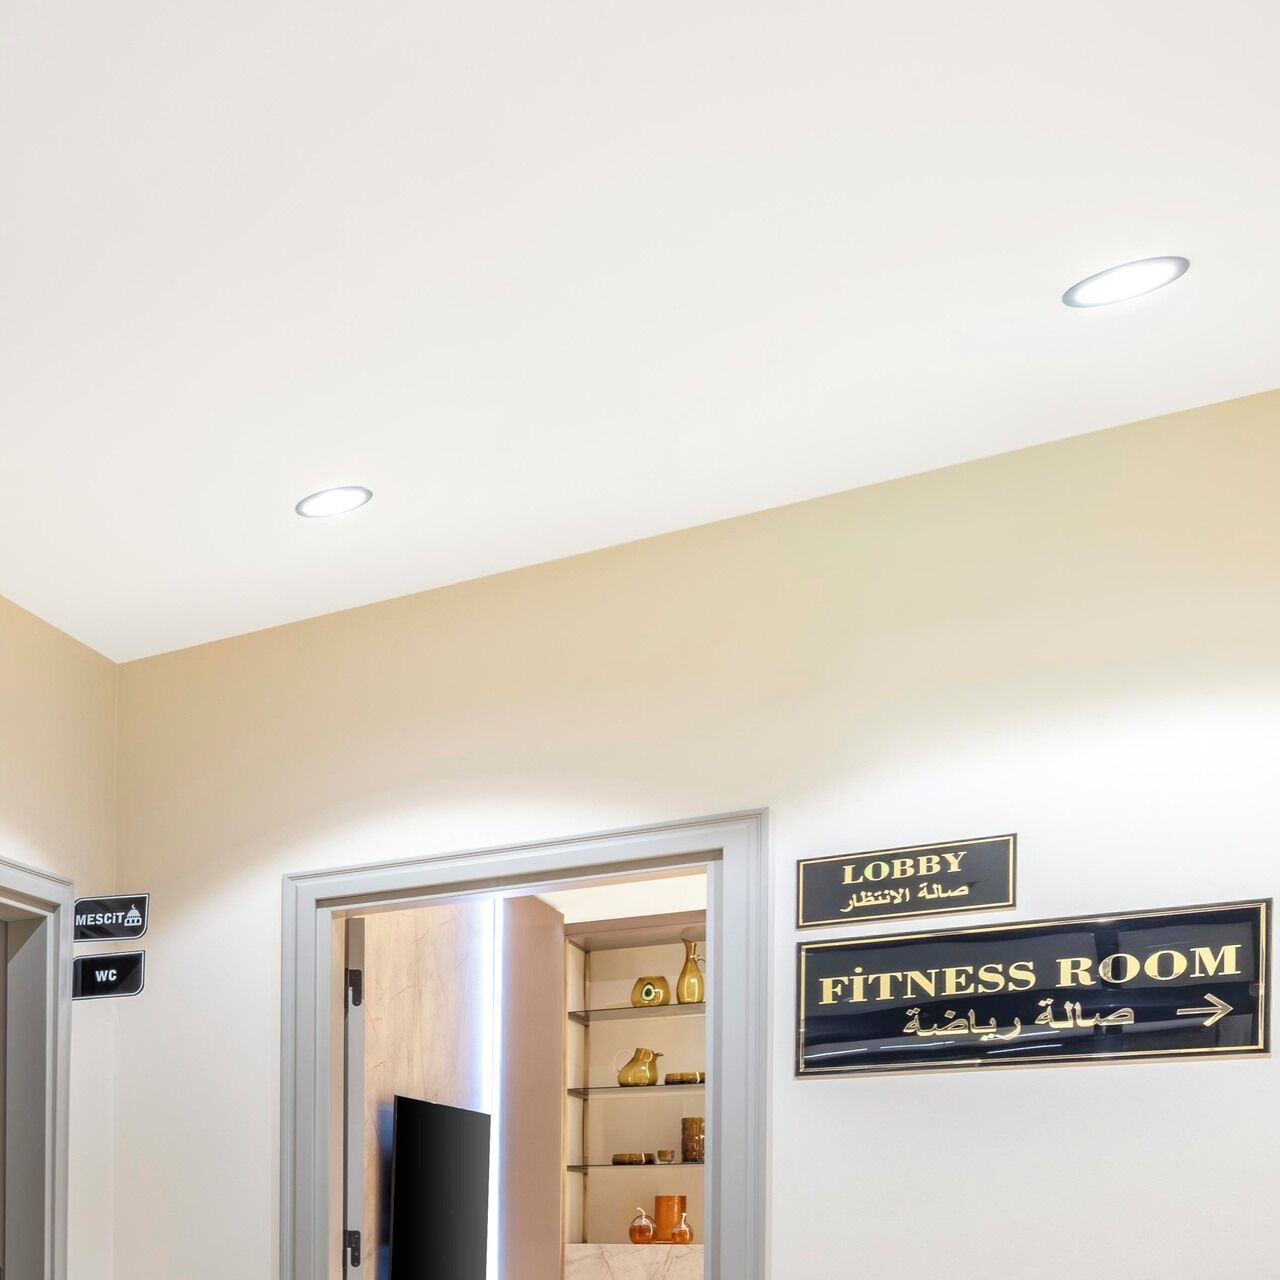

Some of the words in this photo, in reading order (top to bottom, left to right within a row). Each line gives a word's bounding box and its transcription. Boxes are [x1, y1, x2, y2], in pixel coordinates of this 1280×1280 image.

[842, 851, 967, 884] LOBBY
[840, 887, 910, 913] الانتظار
[917, 881, 969, 900] صالة
[96, 969, 117, 982] WC
[1055, 944, 1242, 988] ROOM
[902, 1007, 1022, 1041] رياضة
[1034, 998, 1135, 1029] صالة
